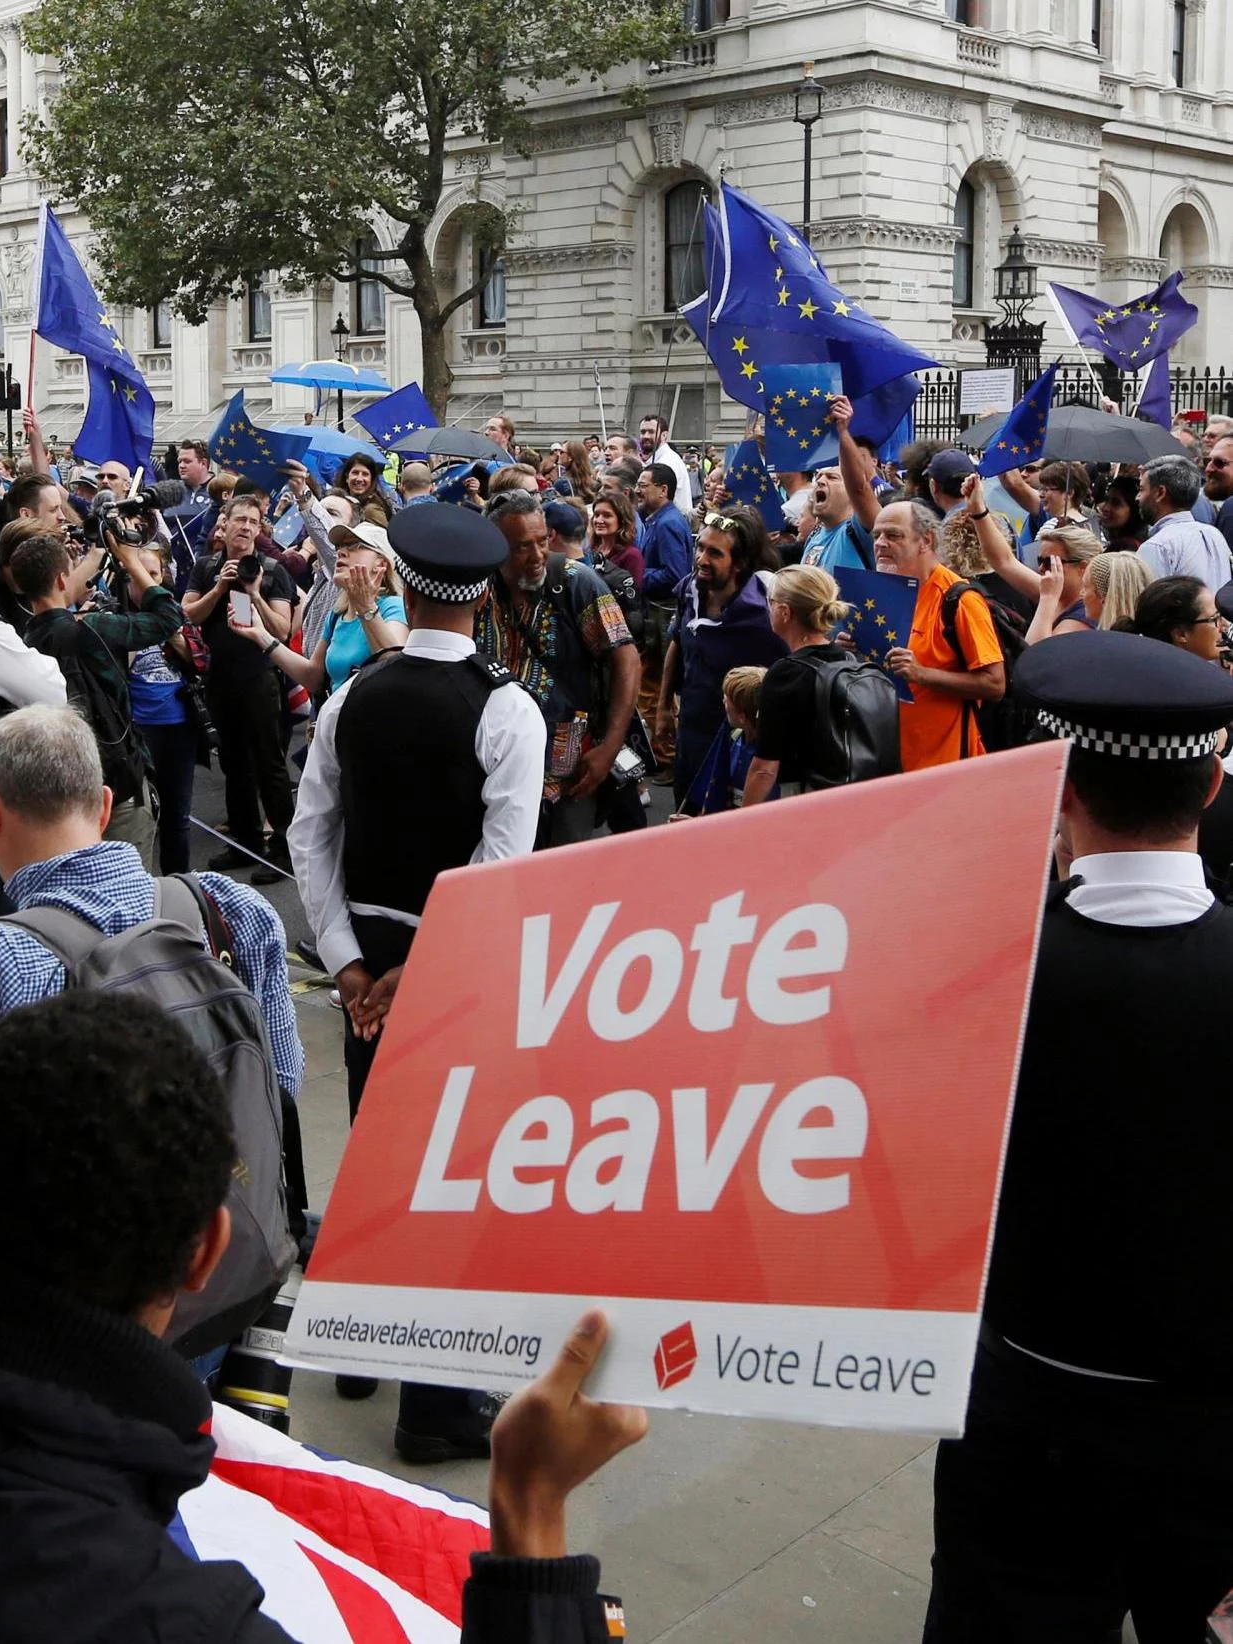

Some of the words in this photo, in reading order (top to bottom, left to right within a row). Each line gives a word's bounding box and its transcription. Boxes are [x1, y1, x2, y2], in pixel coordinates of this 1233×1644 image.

[516, 889, 850, 1049] Vote
[409, 1065, 869, 1215] Leave
[306, 1314, 543, 1365] voteleavetakecontrol.org
[716, 1333, 800, 1385] Vote
[812, 1340, 936, 1396] Leave
